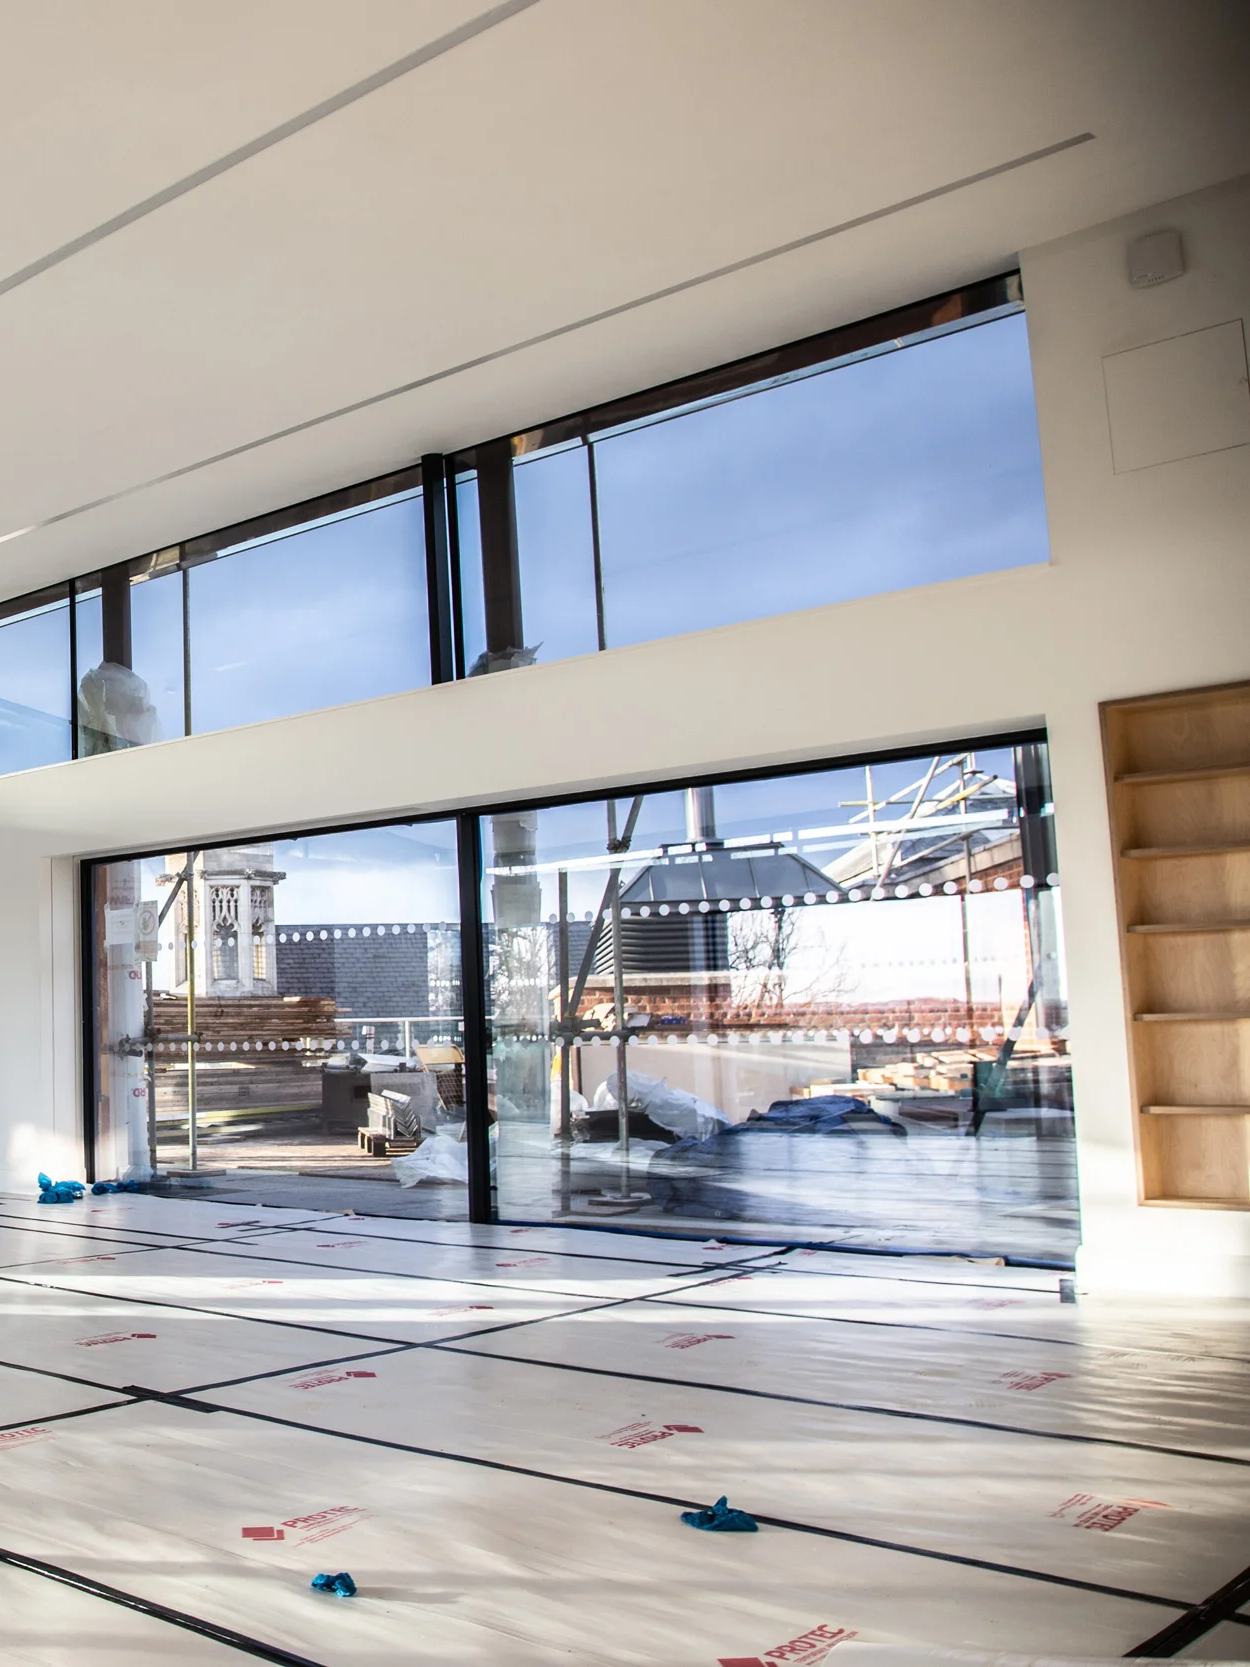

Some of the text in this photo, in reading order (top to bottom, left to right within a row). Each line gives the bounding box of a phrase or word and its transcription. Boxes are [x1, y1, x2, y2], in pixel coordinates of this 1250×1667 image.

[616, 1430, 675, 1449] PROTEC
[280, 1505, 359, 1528] PROTEC
[1084, 1504, 1140, 1532] PROTEC
[763, 1623, 845, 1661] PROTEC
